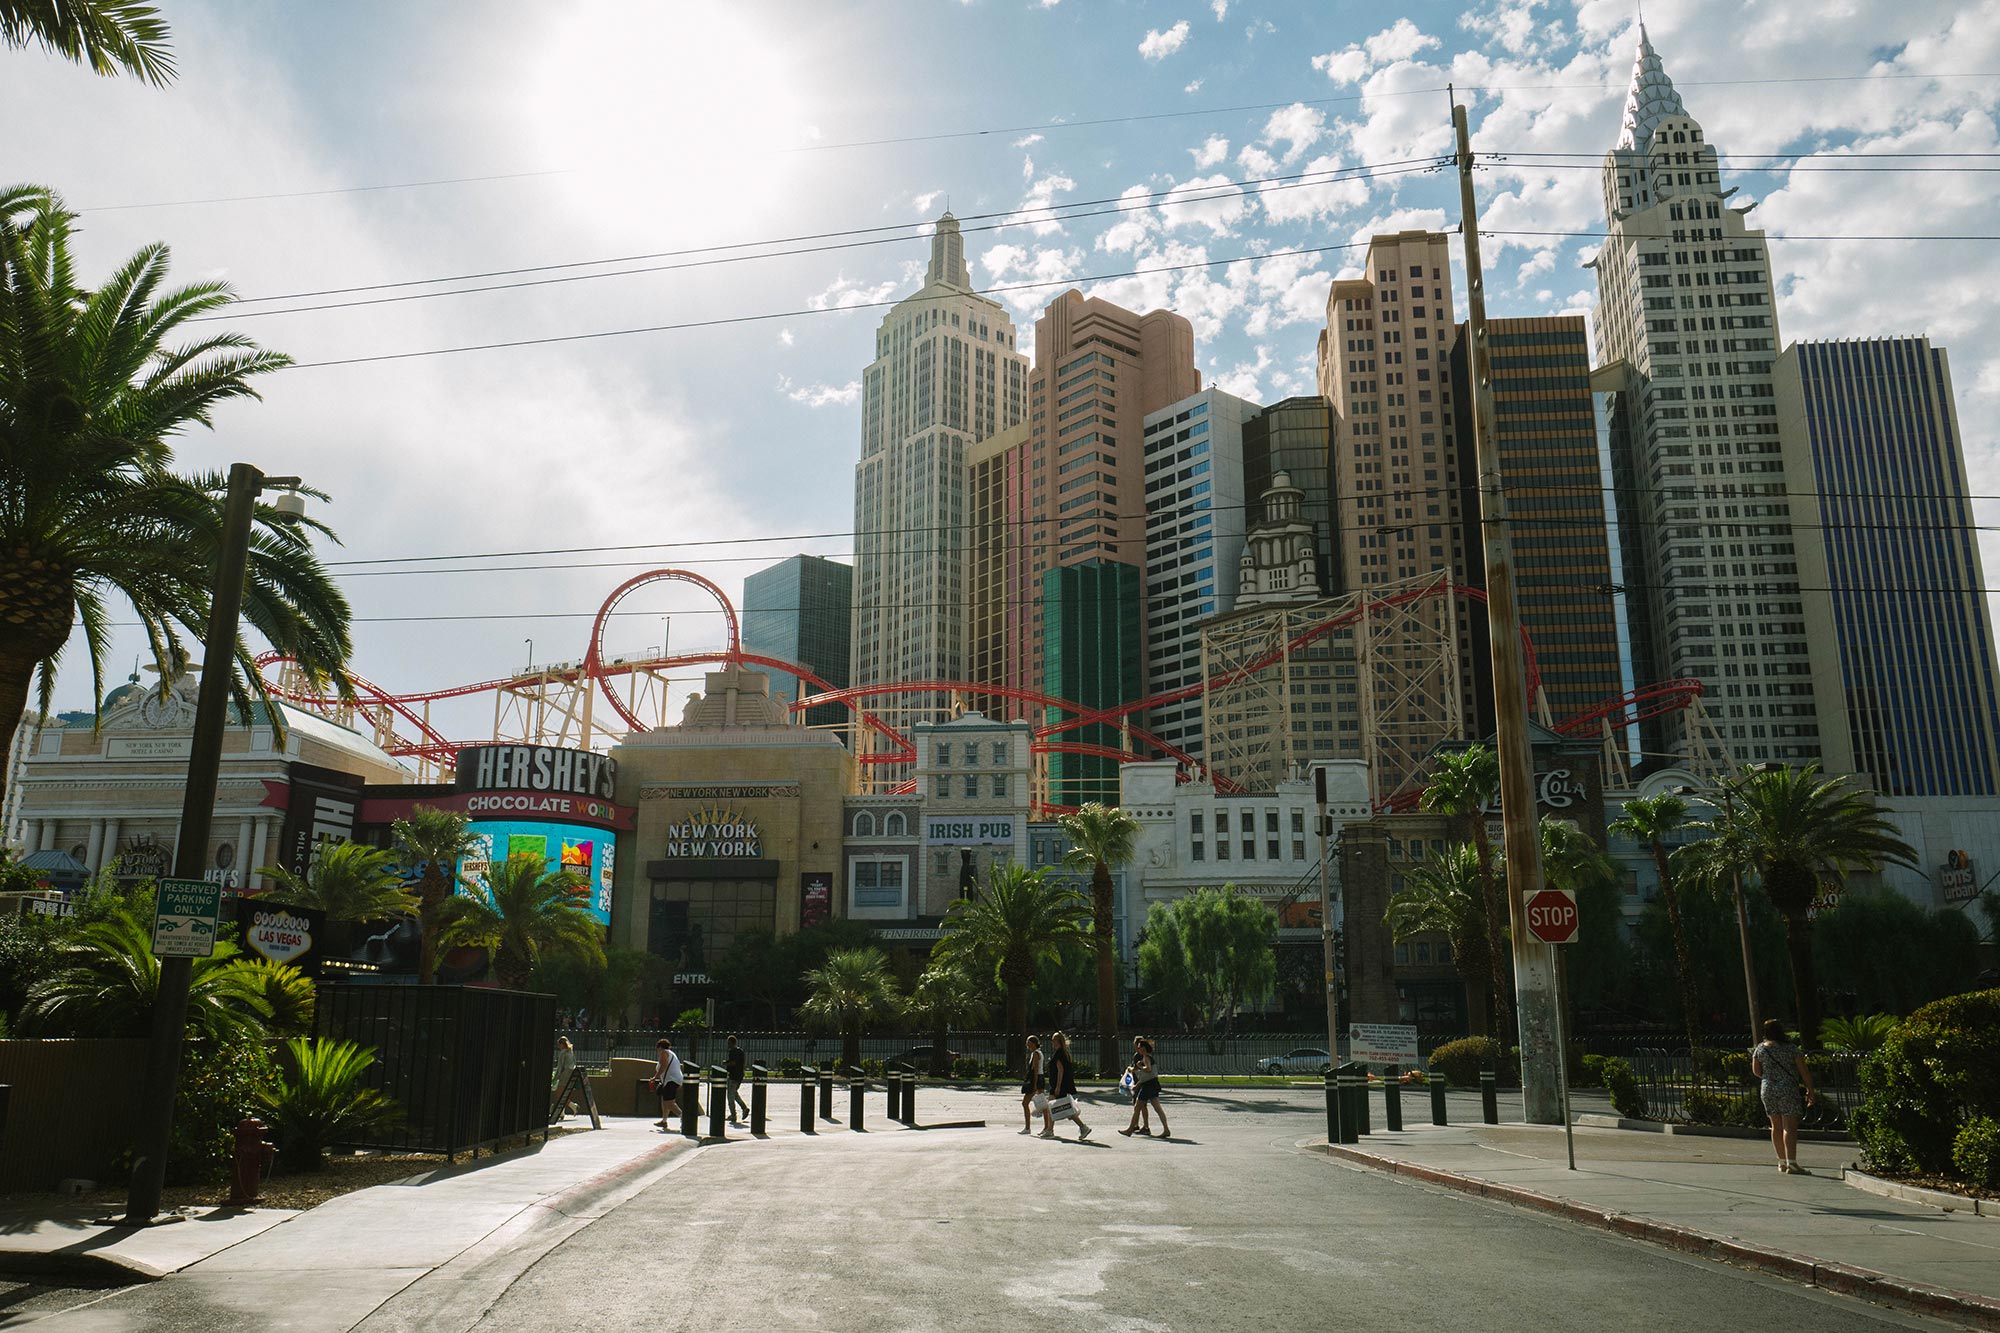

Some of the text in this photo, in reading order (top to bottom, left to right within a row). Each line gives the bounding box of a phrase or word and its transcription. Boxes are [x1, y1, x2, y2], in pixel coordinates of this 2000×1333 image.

[476, 747, 615, 798] HERSHEY'S
[670, 787, 768, 798] NEW YORK NEW YORK
[468, 796, 615, 820] CHOCOLATE WORLD
[669, 824, 757, 838] NEW YORK
[930, 823, 1011, 838] IRISH PUB
[295, 831, 306, 862] MILK
[668, 842, 757, 857] NEW YORK
[164, 883, 217, 895] RESERVED
[1250, 886, 1276, 894] NEW
[1280, 886, 1311, 894] YORK
[166, 894, 213, 905] PARKING
[32, 900, 59, 916] FREE
[174, 905, 204, 915] ONLY
[255, 912, 309, 930] OFFICIAL
[1531, 906, 1574, 926] STOP
[259, 930, 302, 946] LAS VEGAS
[673, 974, 717, 985] ENTRA
